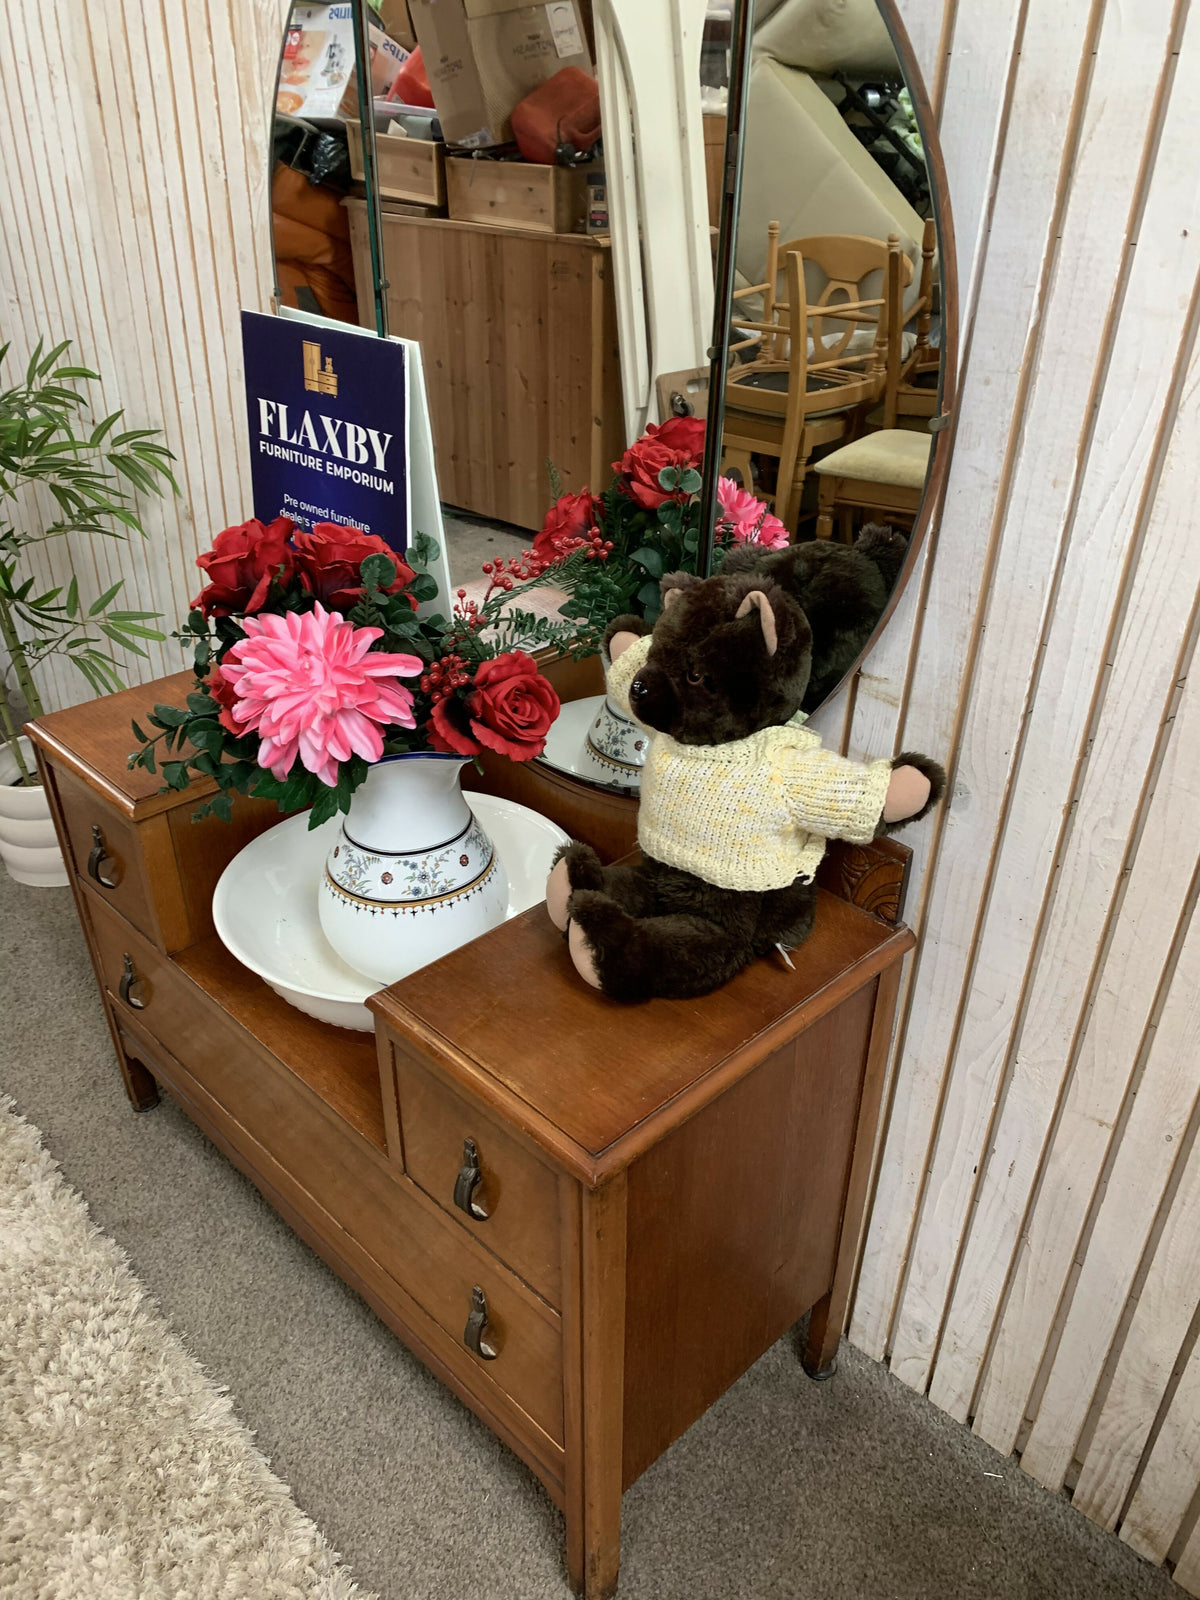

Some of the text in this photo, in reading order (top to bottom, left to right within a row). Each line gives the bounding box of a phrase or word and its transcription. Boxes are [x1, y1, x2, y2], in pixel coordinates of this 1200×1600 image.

[257, 397, 393, 472] FLAXBY
[259, 440, 394, 495] FURNITURE EMPORIUM
[283, 493, 299, 508] Pre
[299, 501, 329, 519] owned
[330, 509, 371, 534] furniture
